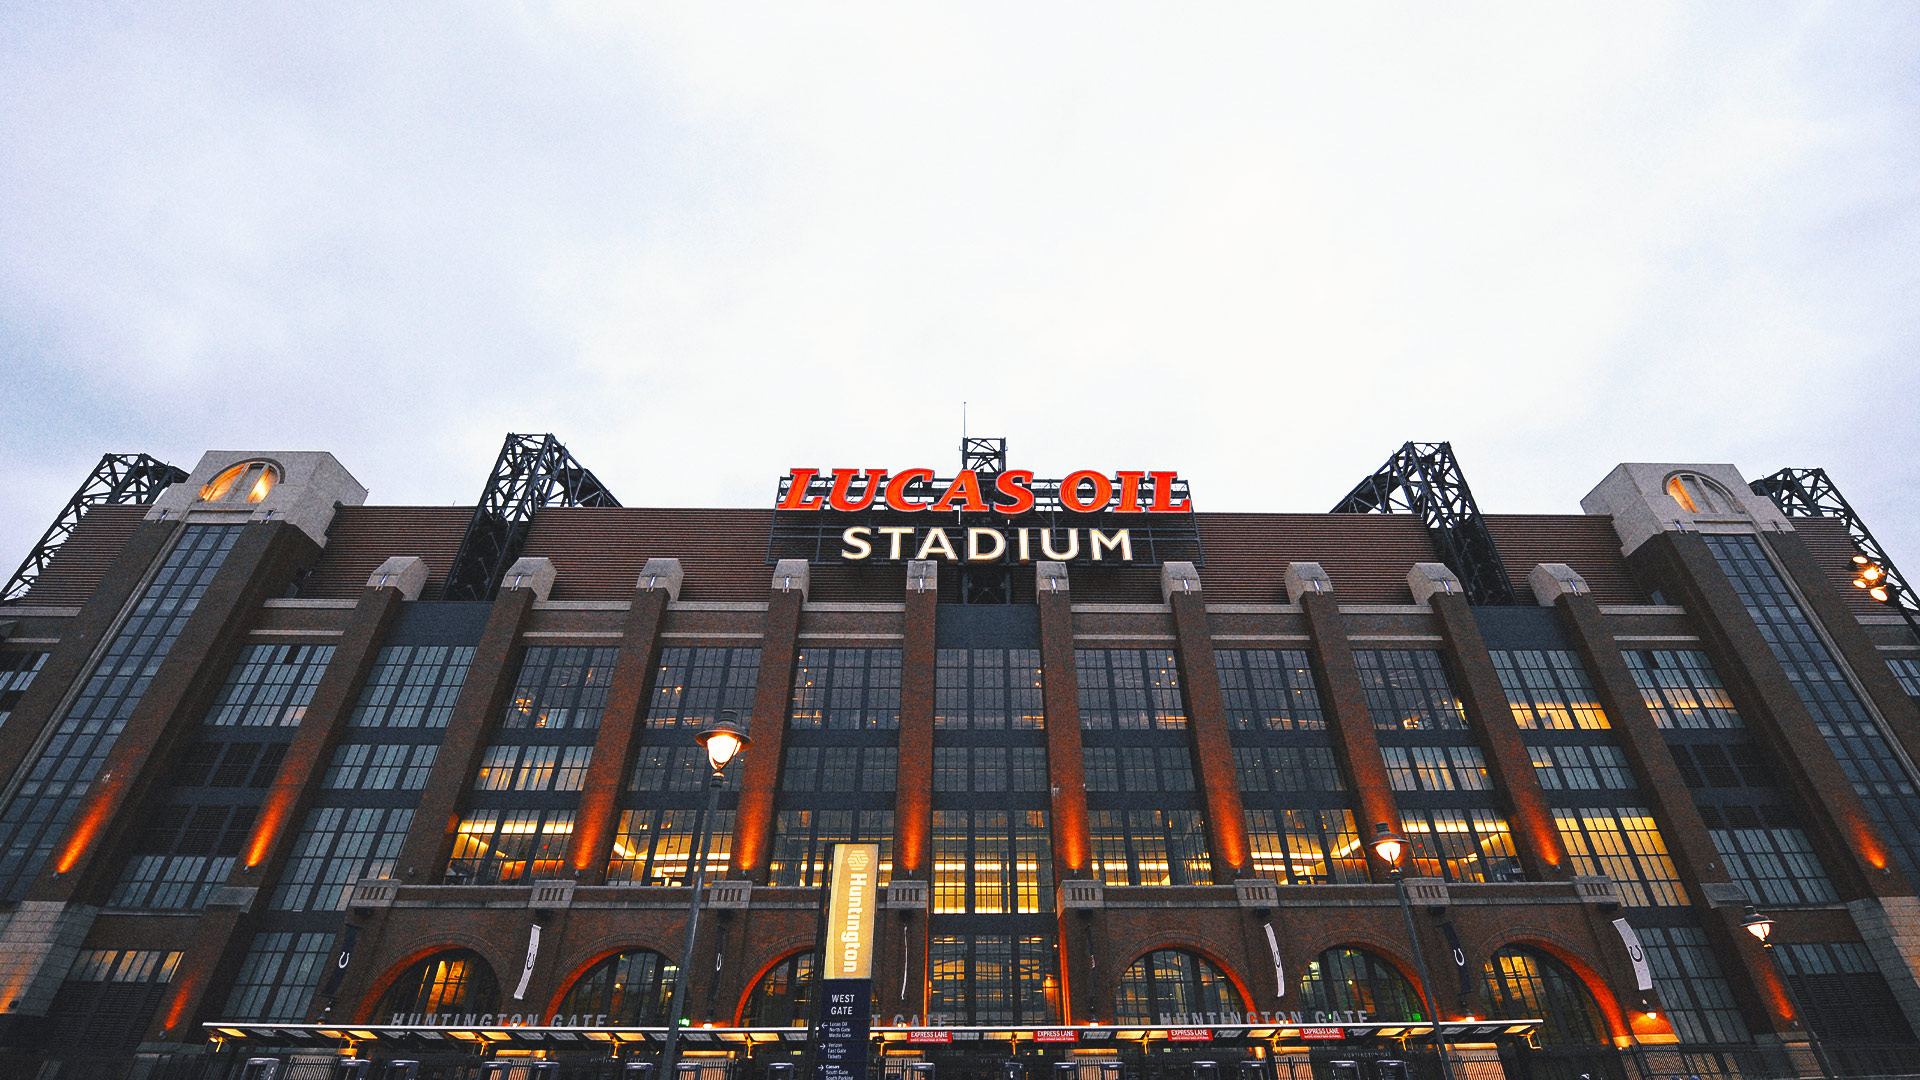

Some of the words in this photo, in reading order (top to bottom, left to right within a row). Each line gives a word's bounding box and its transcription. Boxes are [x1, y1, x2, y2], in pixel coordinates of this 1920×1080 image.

[777, 468, 1034, 514] LUCAS
[1059, 470, 1192, 514] OIL
[842, 526, 1133, 561] STADIUM
[841, 873, 868, 973] Huntington
[831, 994, 855, 1003] WEST
[830, 1006, 853, 1015] GATE
[1160, 1011, 1303, 1025] HUNTINGTON
[1314, 1010, 1368, 1024] GATE
[391, 1013, 539, 1026] HUNTINGTON
[550, 1014, 607, 1027] GATE
[893, 1013, 950, 1027] GATE
